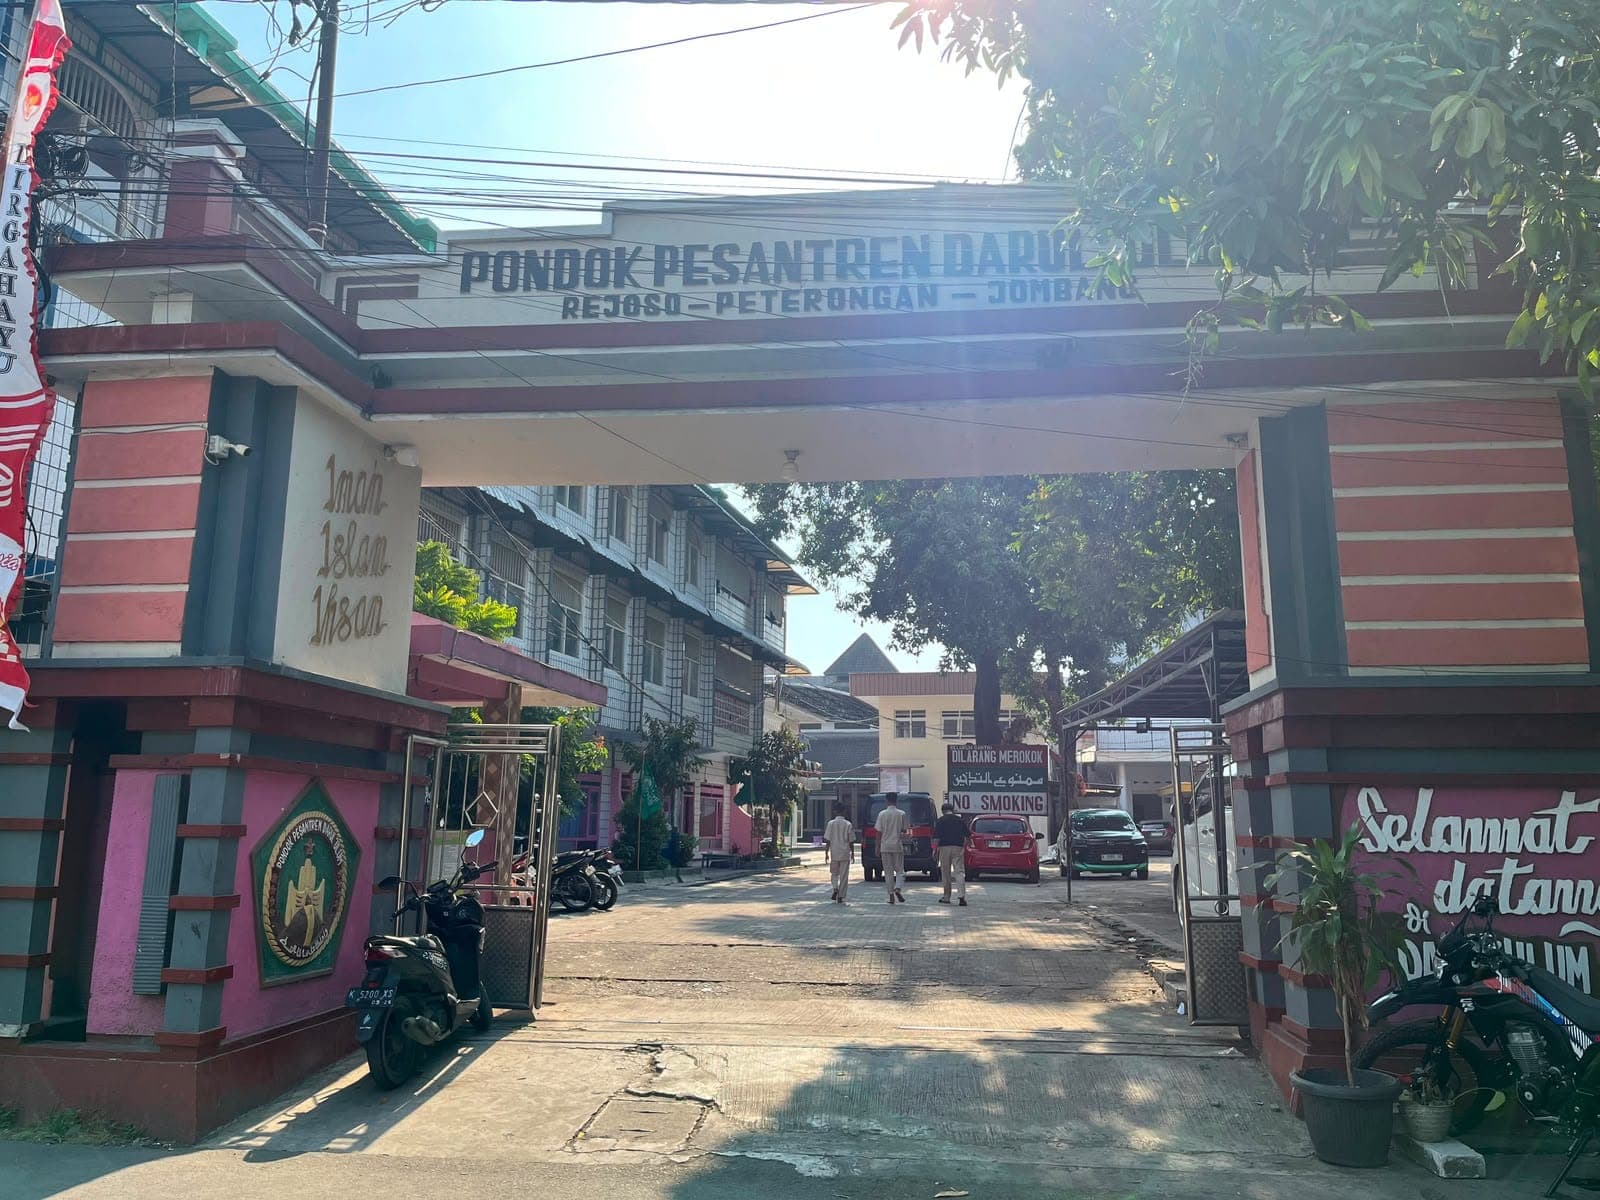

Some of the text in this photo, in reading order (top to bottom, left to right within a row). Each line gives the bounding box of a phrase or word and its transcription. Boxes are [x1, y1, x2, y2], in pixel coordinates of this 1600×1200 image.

[460, 246, 644, 294] PONDOK
[654, 234, 931, 287] PESANTREN
[562, 295, 682, 319] REJOSO
[716, 284, 938, 316] PETERONGAN
[952, 750, 1043, 763] DILARANG MEROKOK
[952, 795, 1044, 812] NO SMOKING
[1358, 787, 1600, 854] Selamat
[1433, 858, 1600, 915] datan
